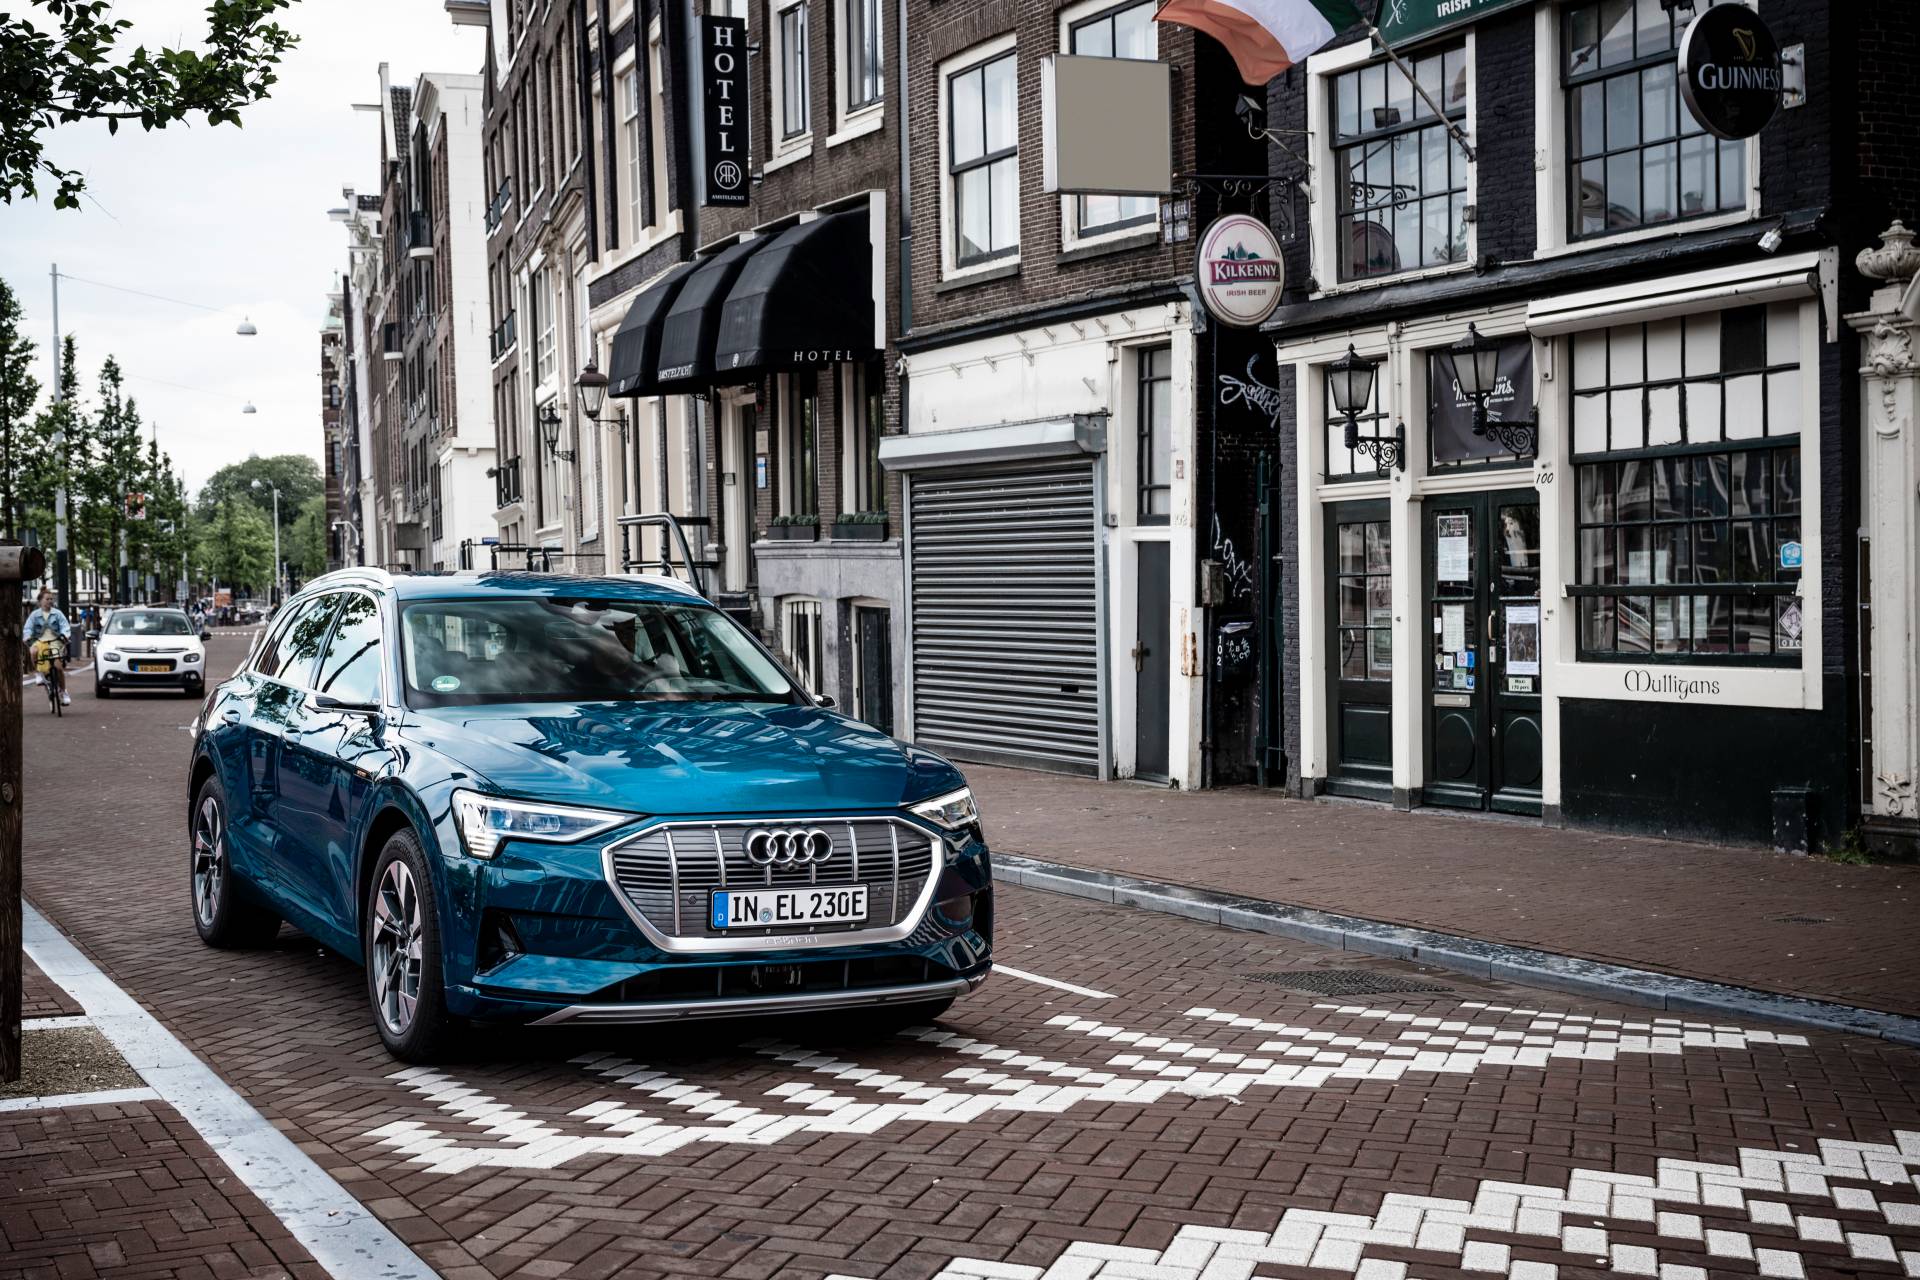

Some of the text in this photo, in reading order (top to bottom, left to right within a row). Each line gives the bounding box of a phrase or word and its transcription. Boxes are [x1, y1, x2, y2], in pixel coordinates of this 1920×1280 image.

[1698, 63, 1781, 90] GUINNESS
[713, 26, 735, 152] HOTEL
[1214, 263, 1277, 280] KILKENNY
[1226, 288, 1267, 297] IRISH BEER
[794, 350, 854, 362] HOTEL
[1536, 472, 1554, 484] 100
[1624, 669, 1720, 700] Mulligans
[731, 890, 865, 923] IN EL 230E
[717, 913, 724, 922] D
